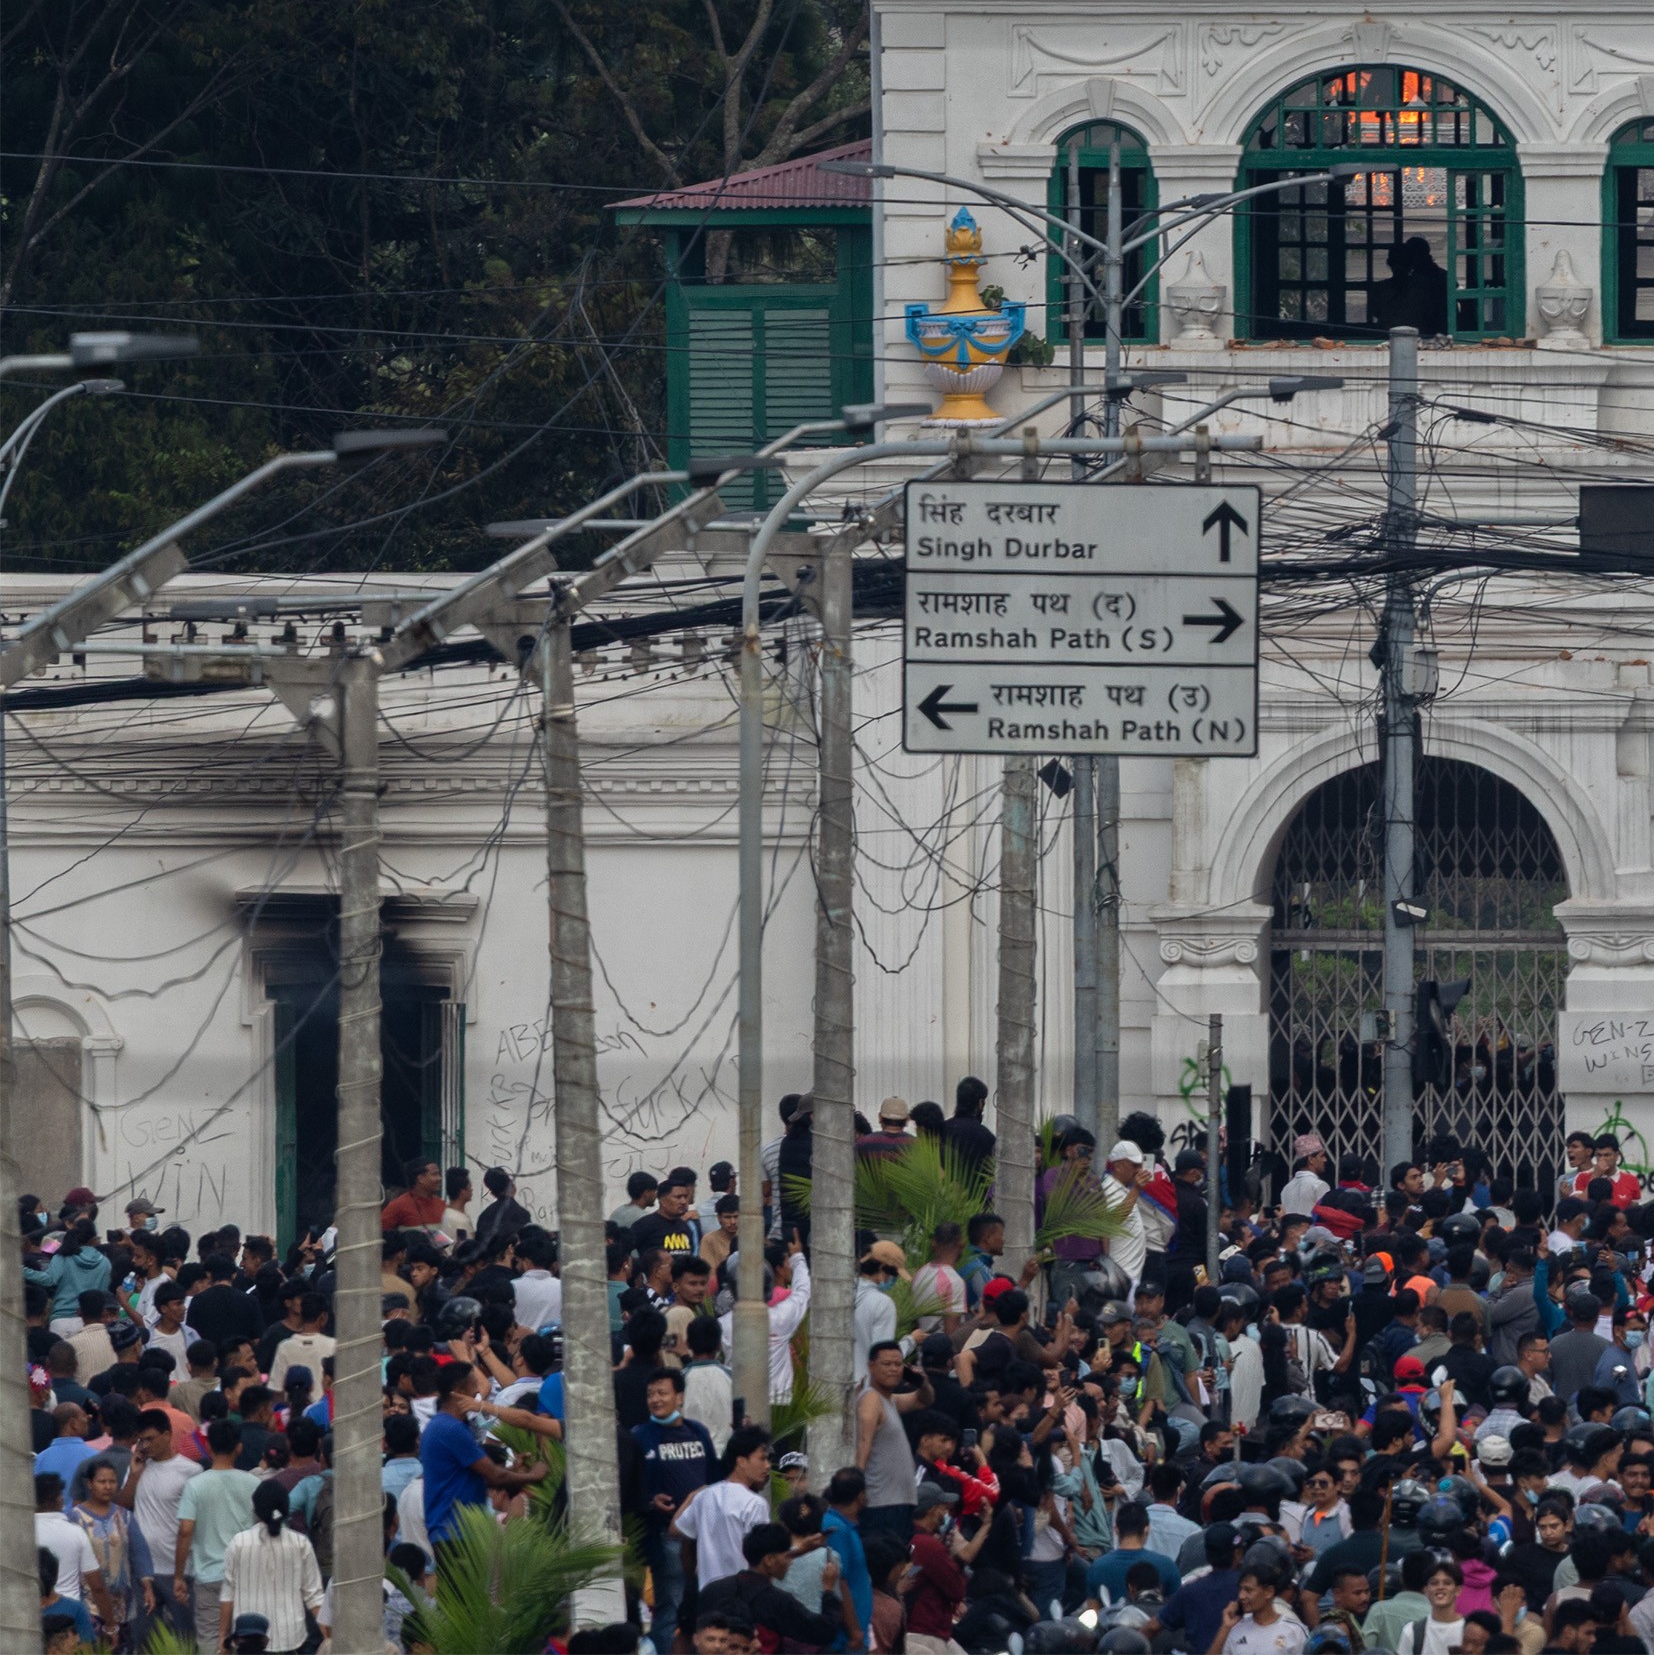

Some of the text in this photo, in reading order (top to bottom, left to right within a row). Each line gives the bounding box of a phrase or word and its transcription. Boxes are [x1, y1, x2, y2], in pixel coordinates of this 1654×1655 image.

[917, 493, 1061, 526] सिंह दरबार
[916, 536, 1099, 563] Singh Durbar
[915, 591, 1012, 617] रामशाह
[1029, 593, 1072, 615] पथ
[914, 625, 1174, 653] Ramshah Path (S)
[989, 684, 1087, 709] रामशाह
[1104, 684, 1147, 707] पथ
[987, 717, 1246, 745] Ramshah Path (N)
